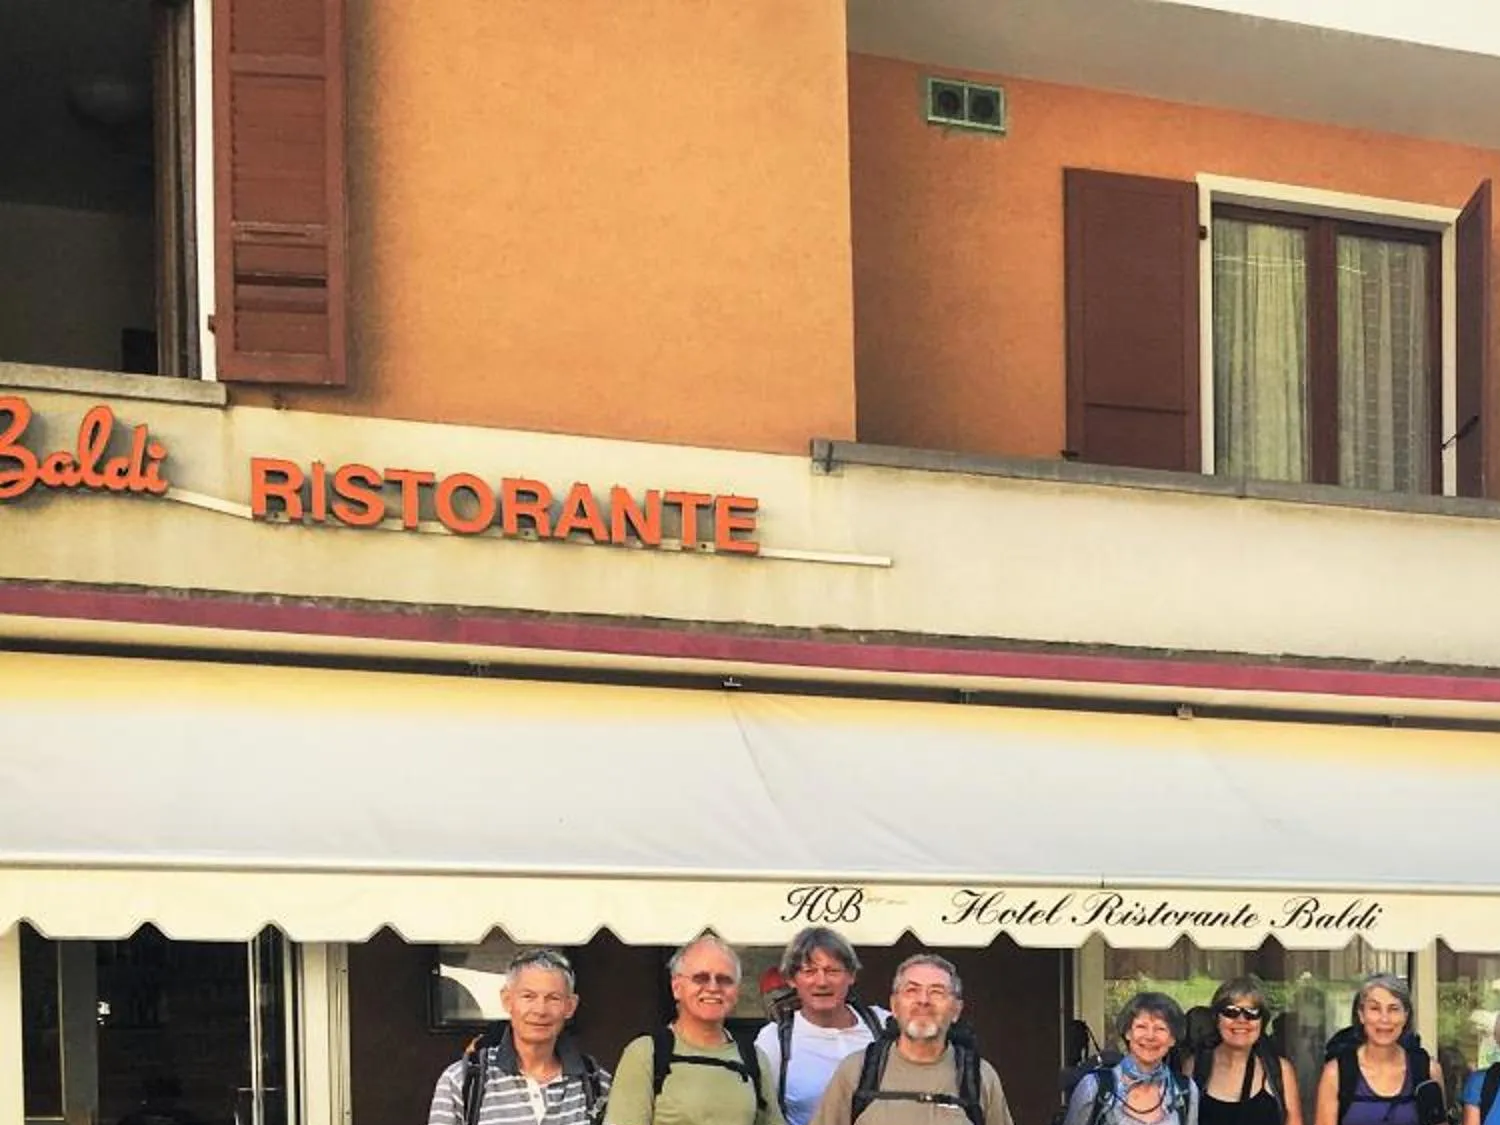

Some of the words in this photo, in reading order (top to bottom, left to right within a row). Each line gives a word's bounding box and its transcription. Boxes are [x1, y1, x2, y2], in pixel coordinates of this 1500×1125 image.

[251, 457, 760, 553] RISTORANTE
[941, 889, 1073, 925] Hotel
[1071, 892, 1260, 928] Ristorante
[1269, 896, 1383, 929] Baldi
